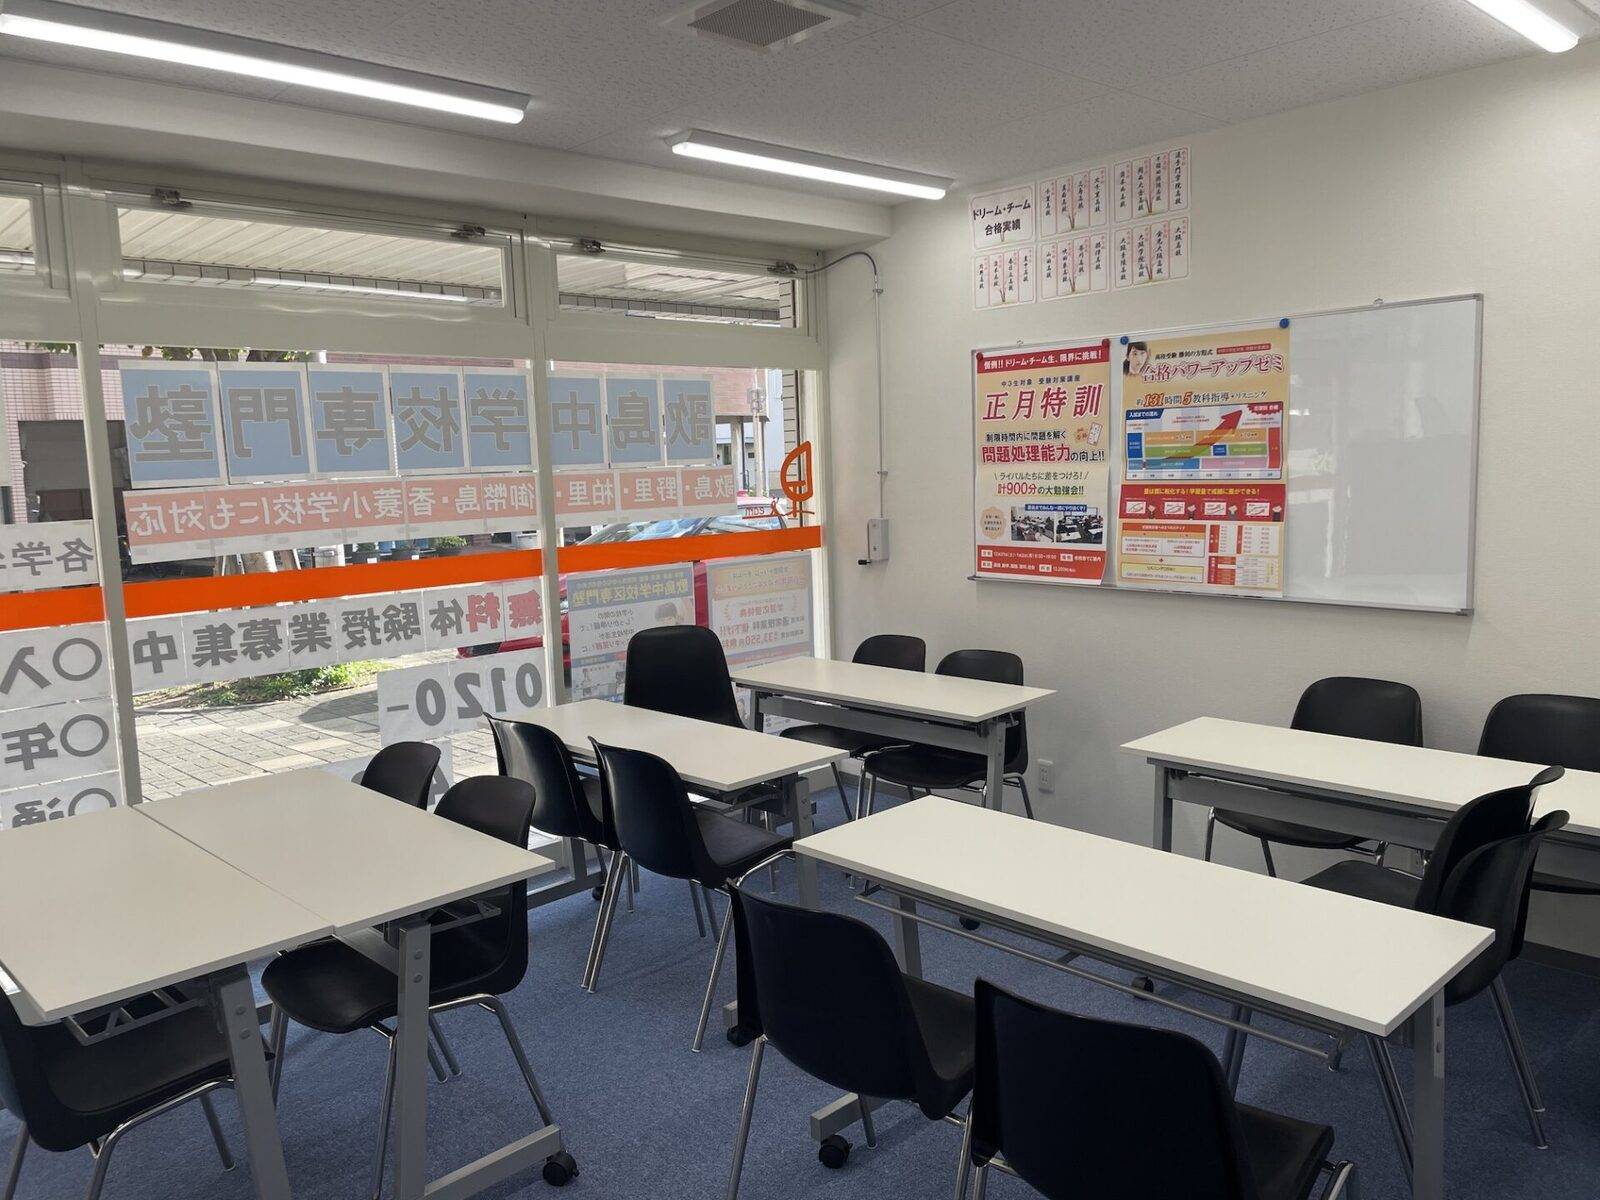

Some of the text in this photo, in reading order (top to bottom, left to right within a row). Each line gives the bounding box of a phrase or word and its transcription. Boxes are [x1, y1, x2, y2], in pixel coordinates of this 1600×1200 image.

[972, 199, 1031, 221] ドリーム・チーム
[984, 219, 1021, 236] 合格実績
[1141, 354, 1284, 384] 合格パワーアップゼミ
[982, 384, 1103, 420] 正月特訓
[986, 430, 1067, 443] 制限時間内に問題を解く
[982, 443, 1105, 463] 問題処理能力の向上!!
[998, 482, 1084, 496] 計900分の大勉強会!!
